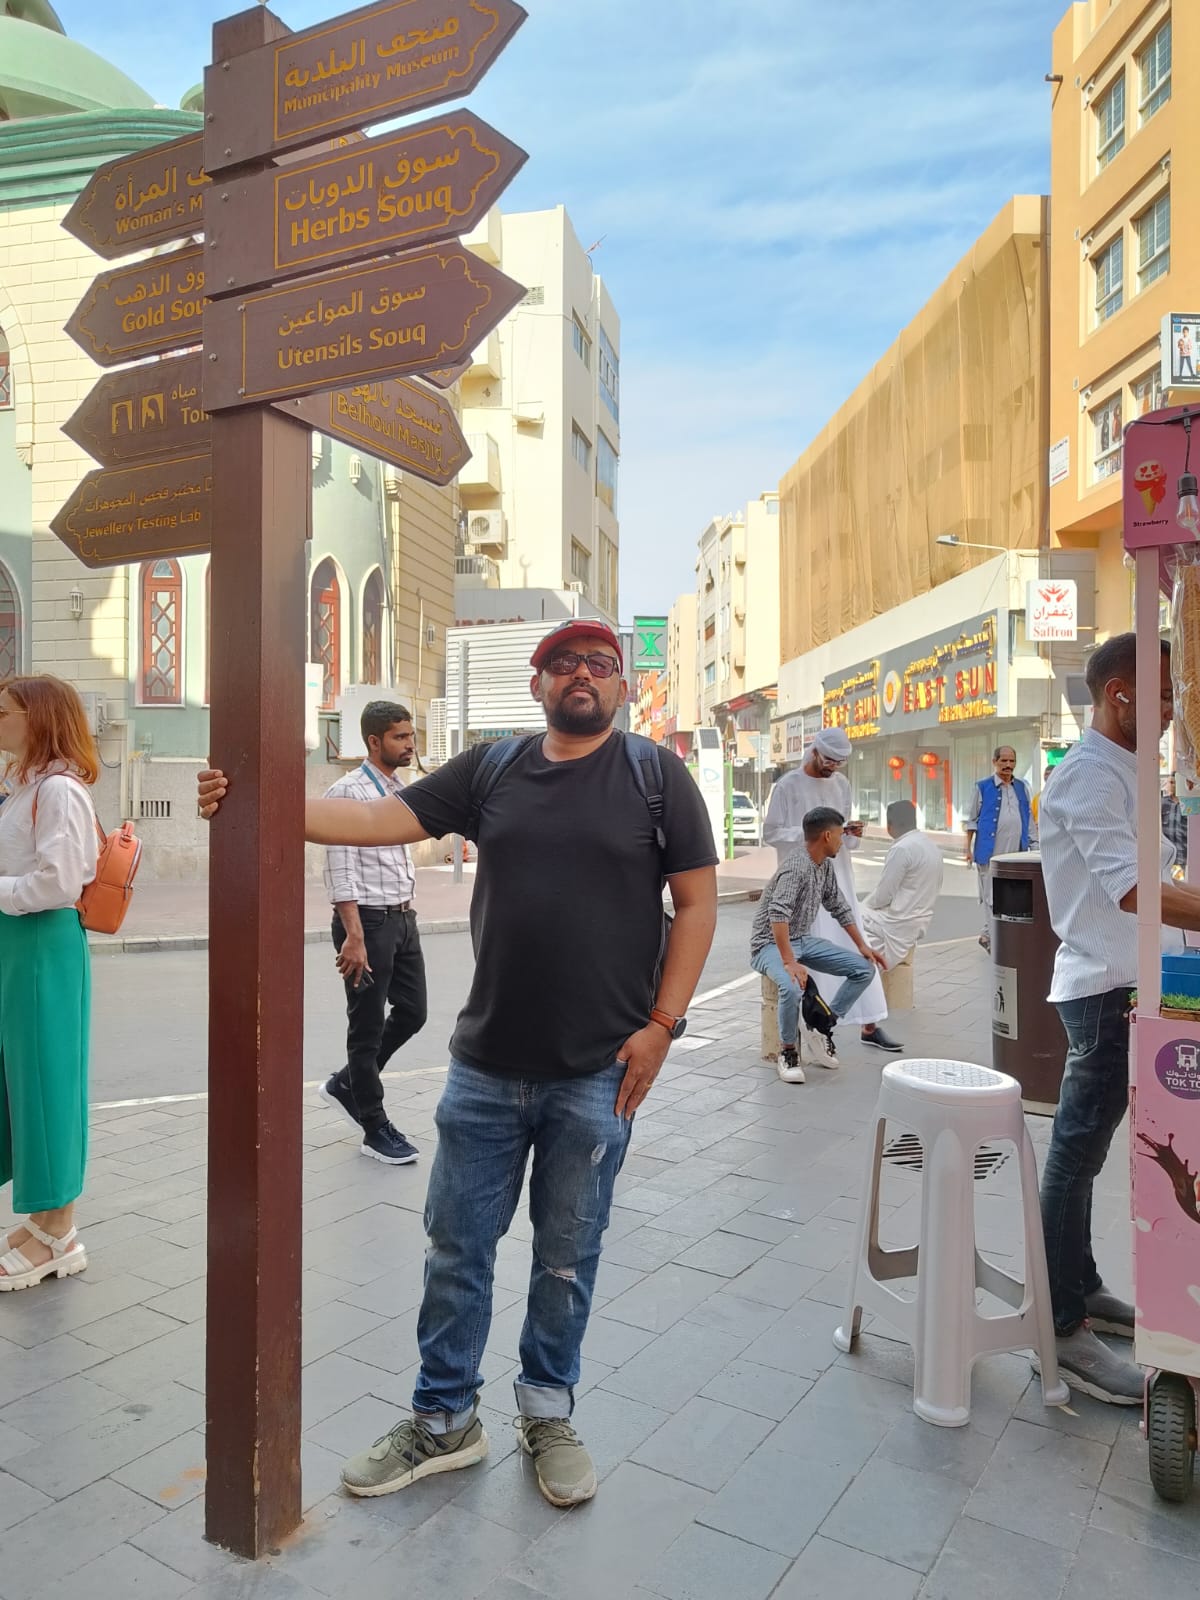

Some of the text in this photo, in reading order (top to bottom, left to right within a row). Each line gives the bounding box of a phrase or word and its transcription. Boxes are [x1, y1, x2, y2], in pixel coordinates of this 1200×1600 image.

[284, 46, 460, 114] Municipality Museum
[384, 147, 460, 189] سوق
[115, 165, 178, 213] المرأة
[115, 200, 185, 234] Woman's
[291, 184, 452, 247] Herbs Souq
[115, 272, 170, 307] الذهب
[122, 296, 213, 333] Gold Sou
[278, 284, 426, 337] سوق المواعين
[278, 323, 426, 369] Utensils Souq
[171, 383, 197, 403] مياه
[337, 393, 443, 462] Belhoul Masjid
[83, 508, 201, 539] Jewellery Testing Lab
[1033, 626, 1073, 637] Saffron
[903, 675, 947, 713] EAST
[955, 661, 997, 700] SUN
[854, 693, 880, 722] SUN
[1165, 1077, 1187, 1087] TOK
